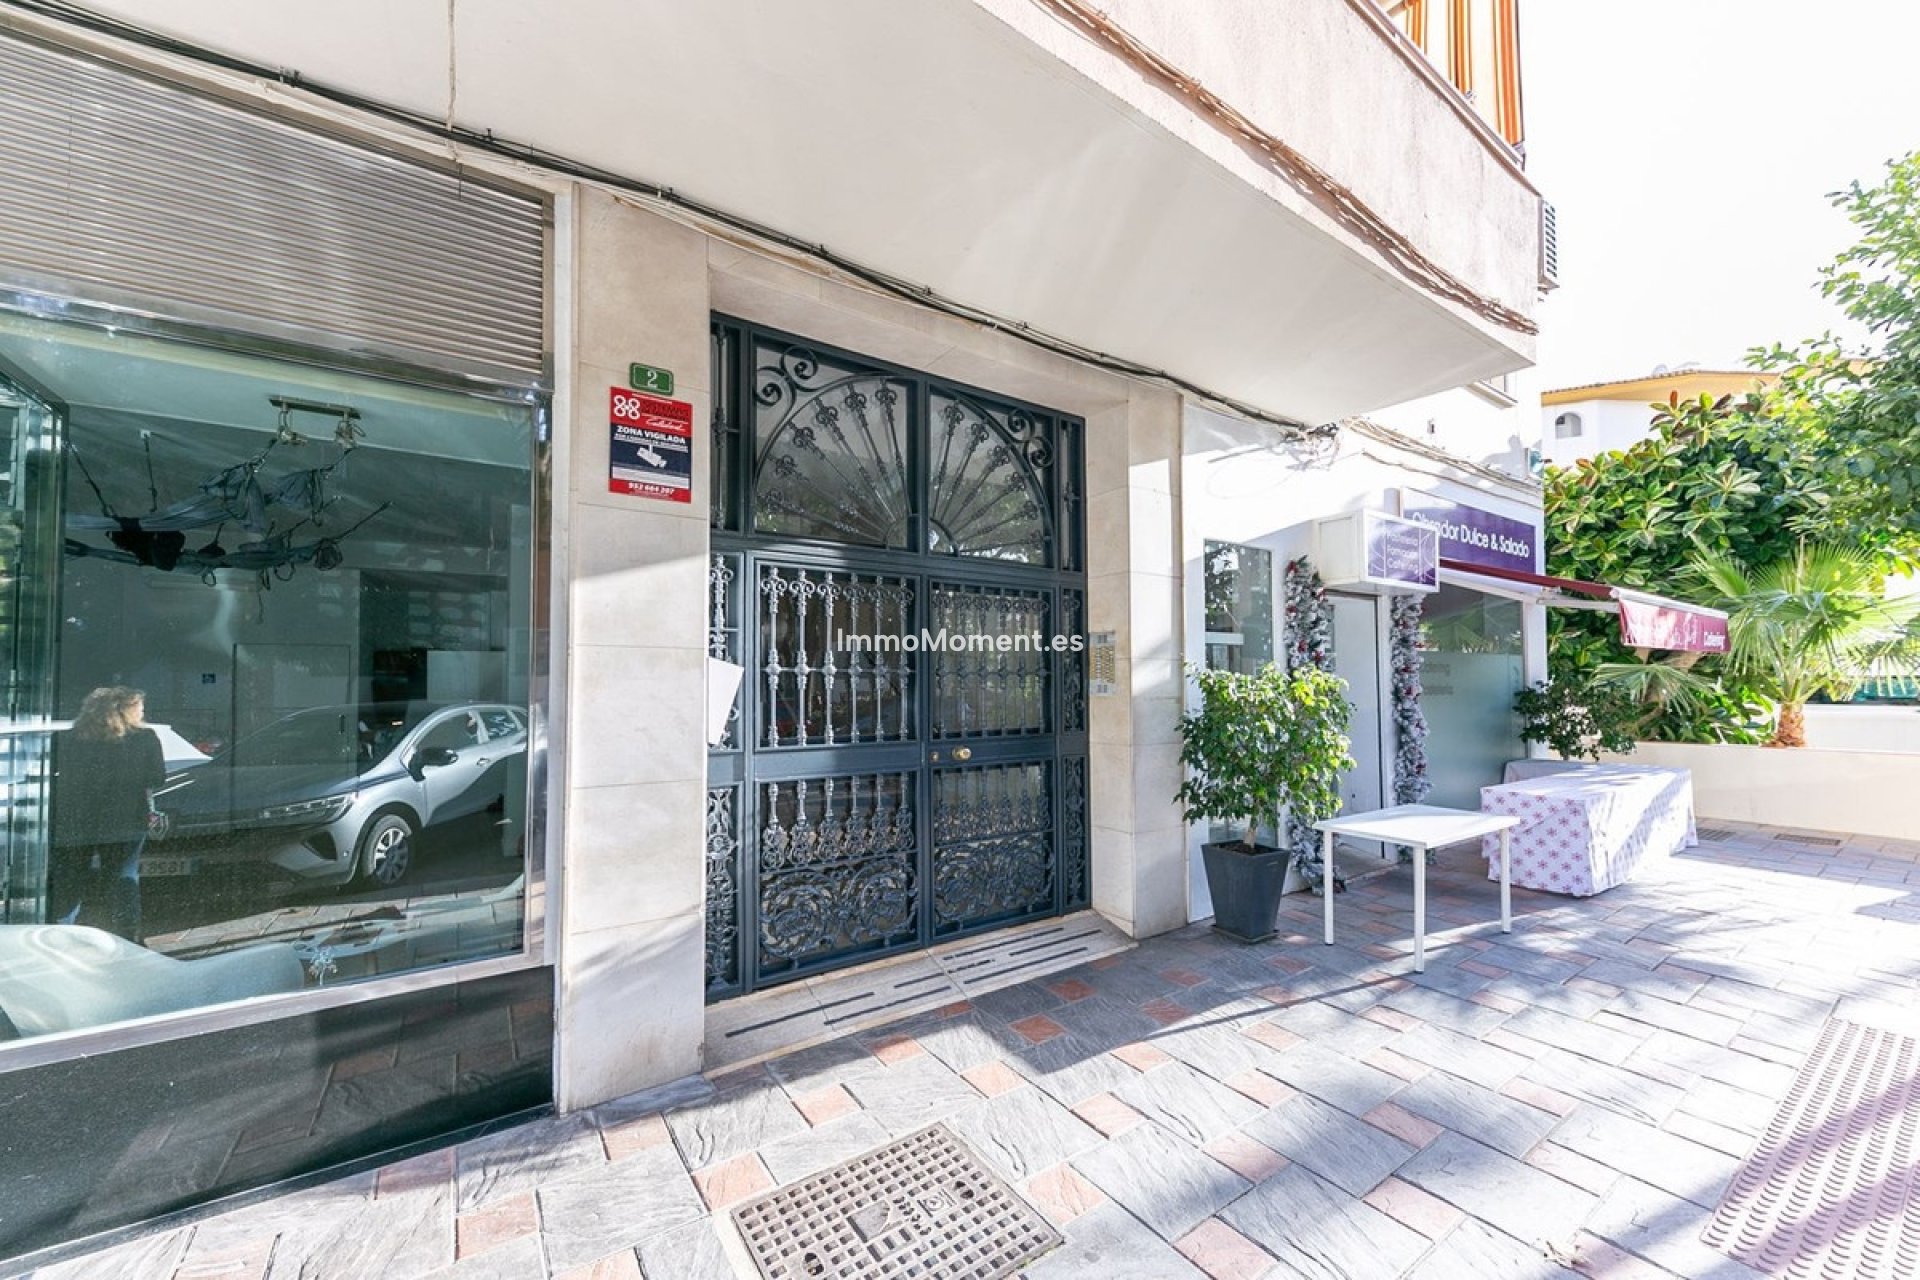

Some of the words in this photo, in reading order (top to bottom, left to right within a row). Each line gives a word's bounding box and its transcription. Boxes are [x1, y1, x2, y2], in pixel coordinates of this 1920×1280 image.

[647, 368, 658, 389] 2
[617, 425, 643, 437] ZONA
[644, 430, 686, 444] VIGILADA
[1460, 524, 1489, 548] Dulce
[1490, 533, 1498, 552] &
[1499, 534, 1530, 558] Salado
